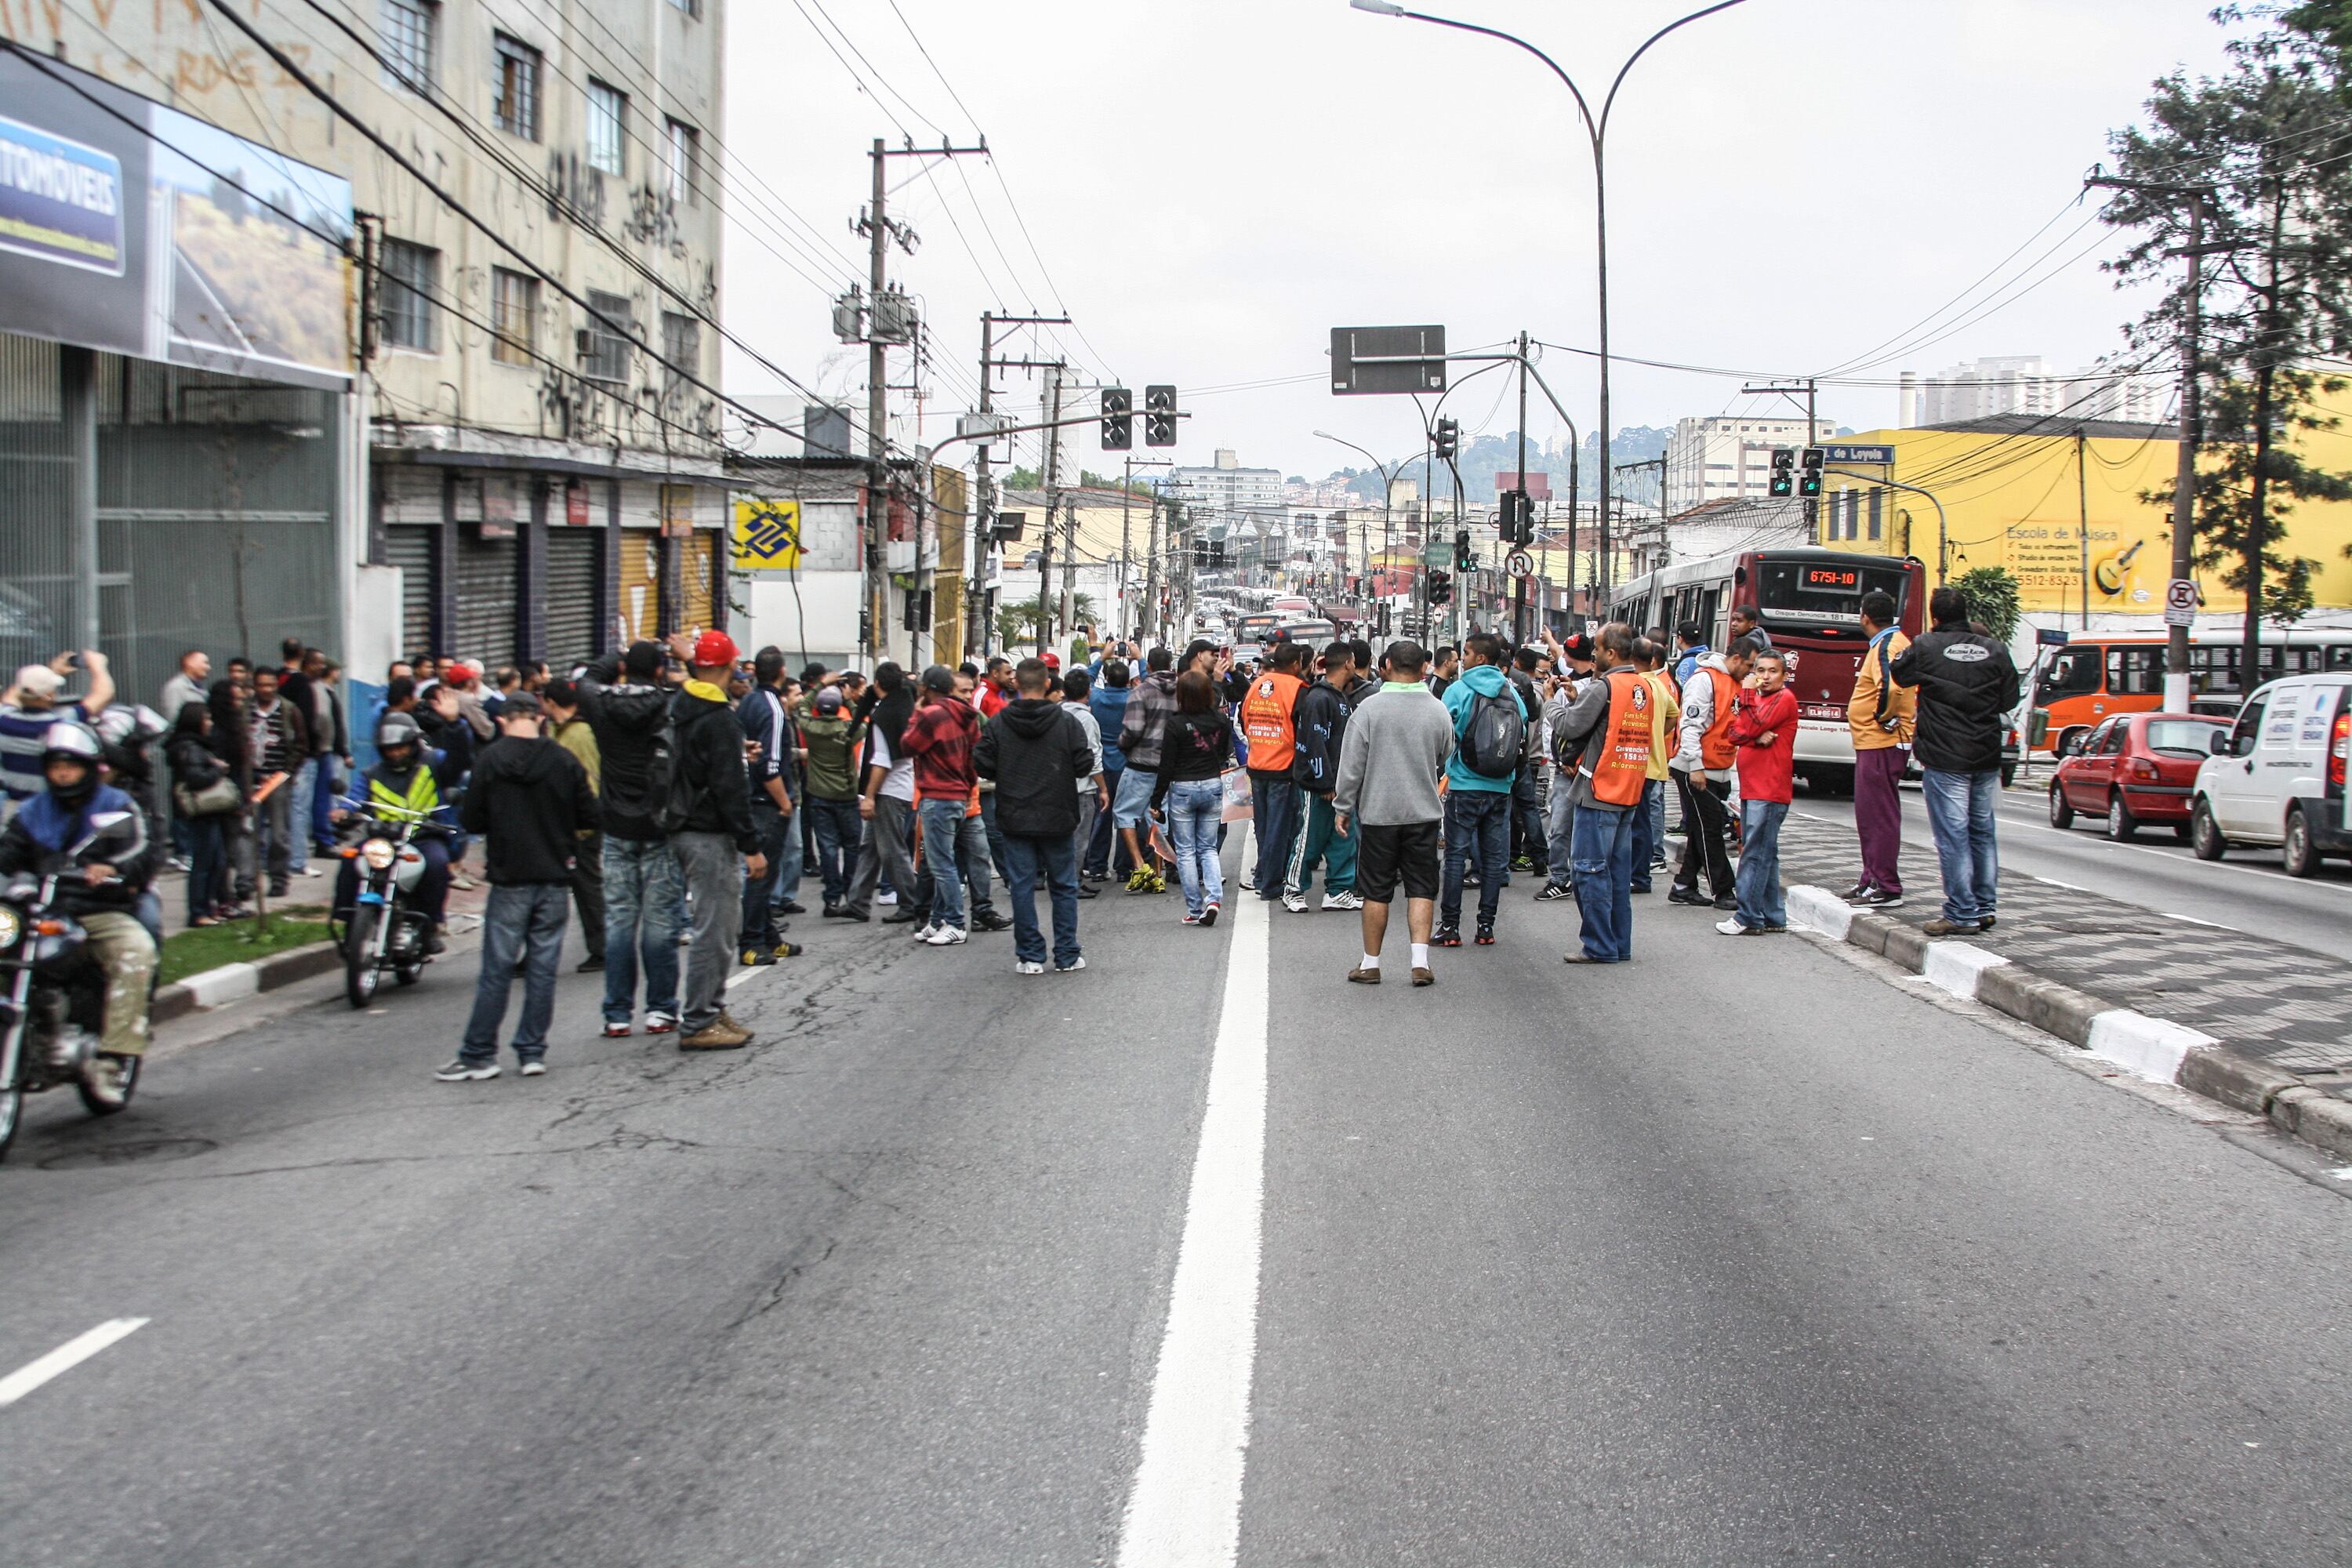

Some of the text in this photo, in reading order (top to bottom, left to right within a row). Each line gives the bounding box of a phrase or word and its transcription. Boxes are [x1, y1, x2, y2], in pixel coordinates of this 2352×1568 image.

[1835, 448, 1846, 459] de
[1850, 448, 1883, 461] Loyola
[2007, 526, 2049, 539] Escola
[2054, 528, 2069, 539] de
